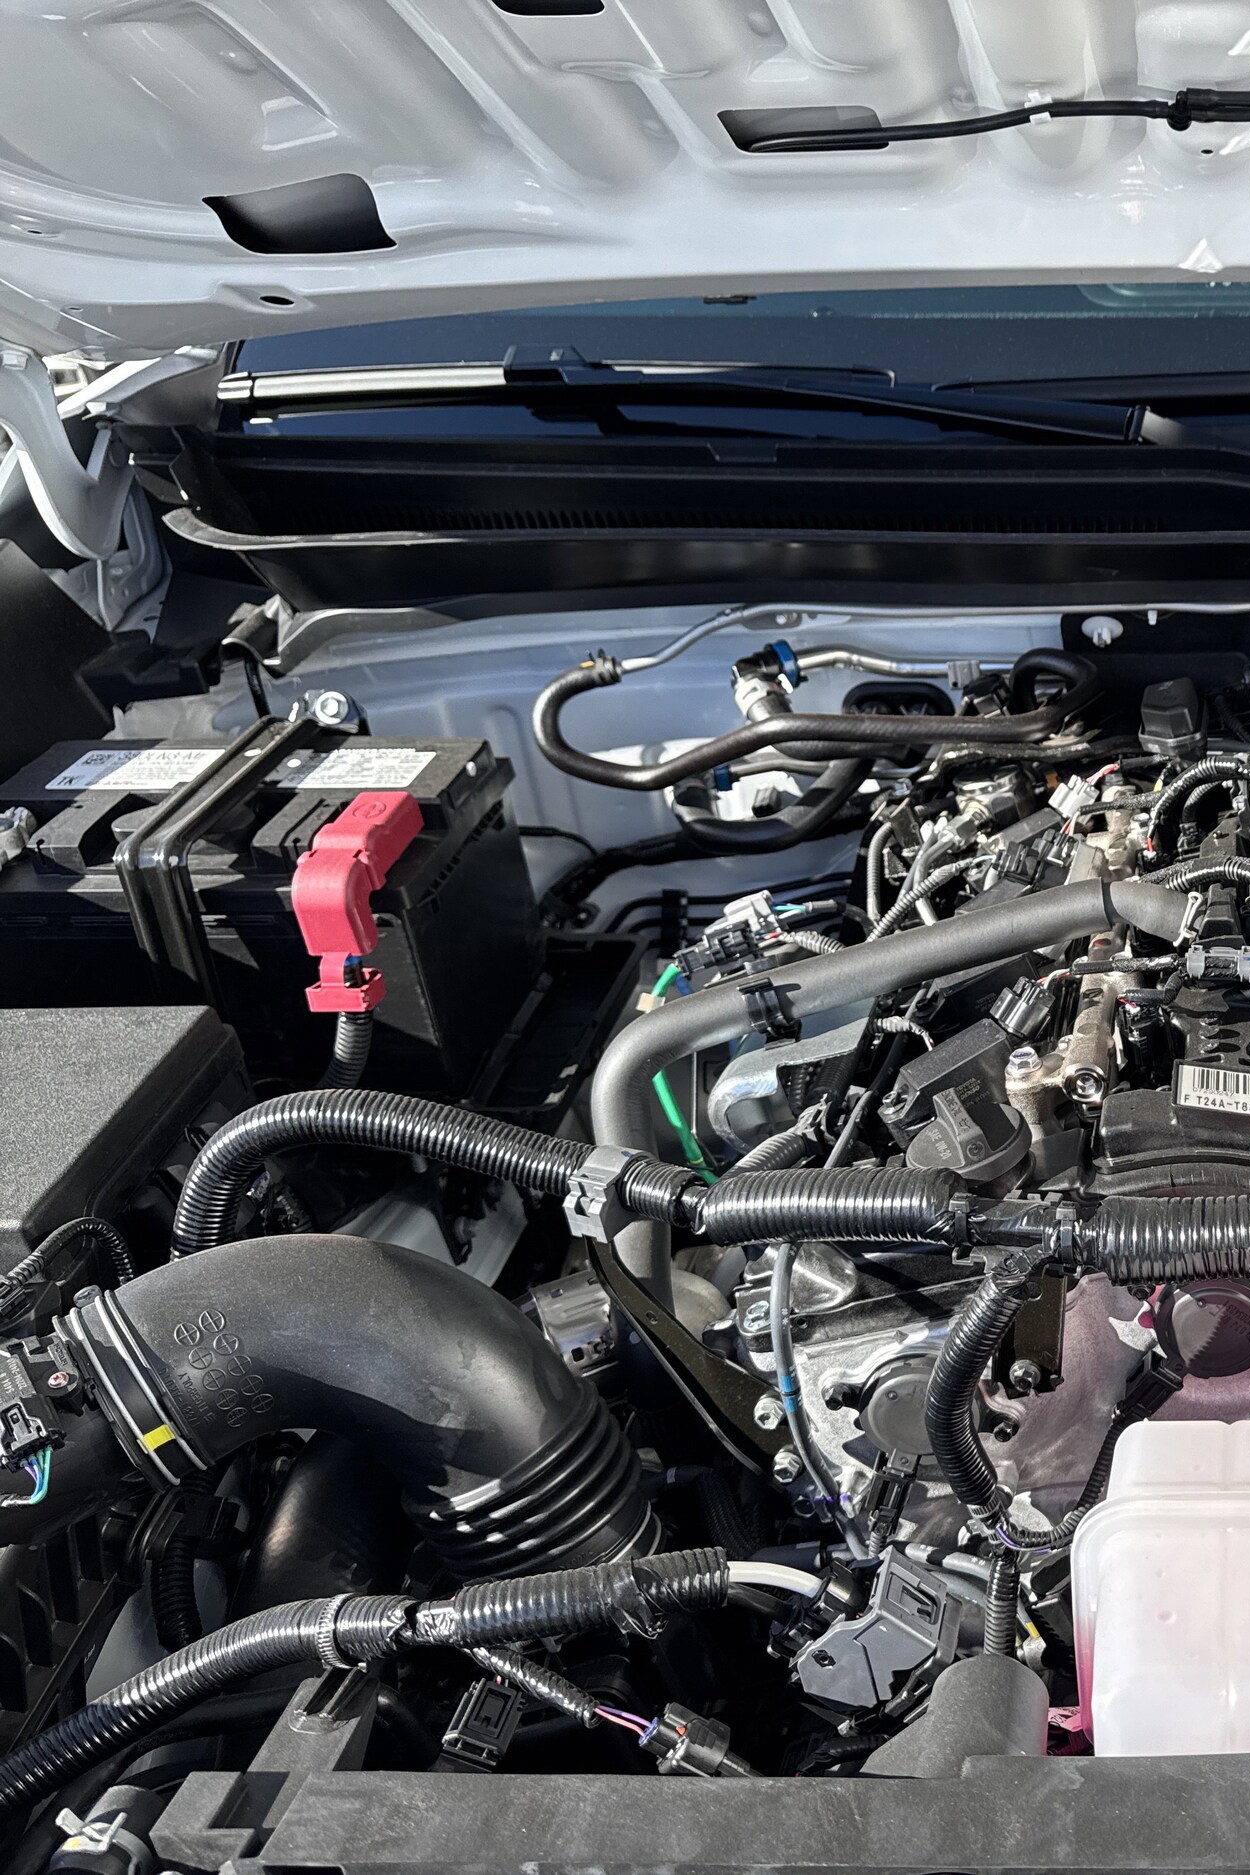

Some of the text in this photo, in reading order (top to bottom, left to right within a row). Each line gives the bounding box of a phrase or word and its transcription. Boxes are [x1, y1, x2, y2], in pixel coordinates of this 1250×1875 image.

[1184, 1094, 1190, 1103] F
[928, 1128, 942, 1142] SAE
[53, 1342, 68, 1366] HITACHI
